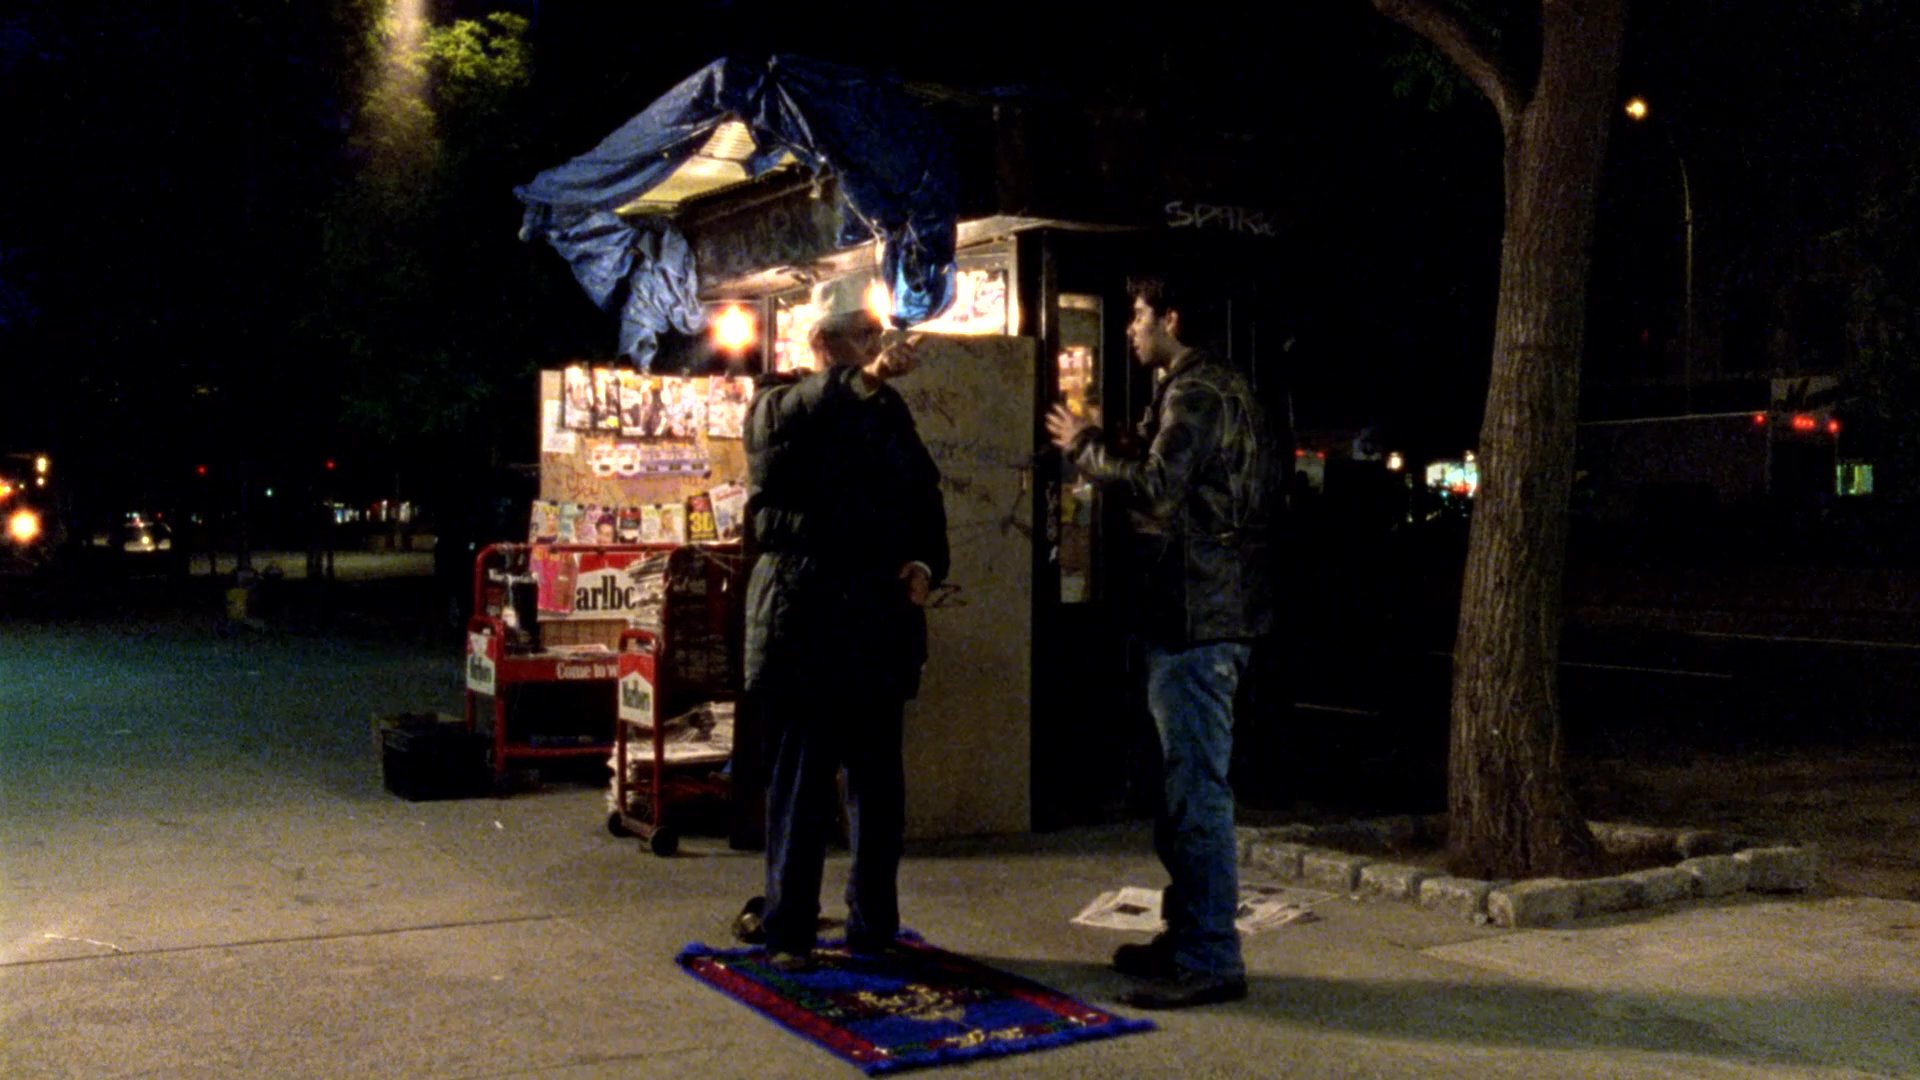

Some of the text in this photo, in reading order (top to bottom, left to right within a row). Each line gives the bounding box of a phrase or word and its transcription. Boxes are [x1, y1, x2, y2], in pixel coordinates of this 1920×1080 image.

[576, 574, 636, 611] arlbo
[556, 662, 590, 680] Come
[593, 664, 606, 679] to
